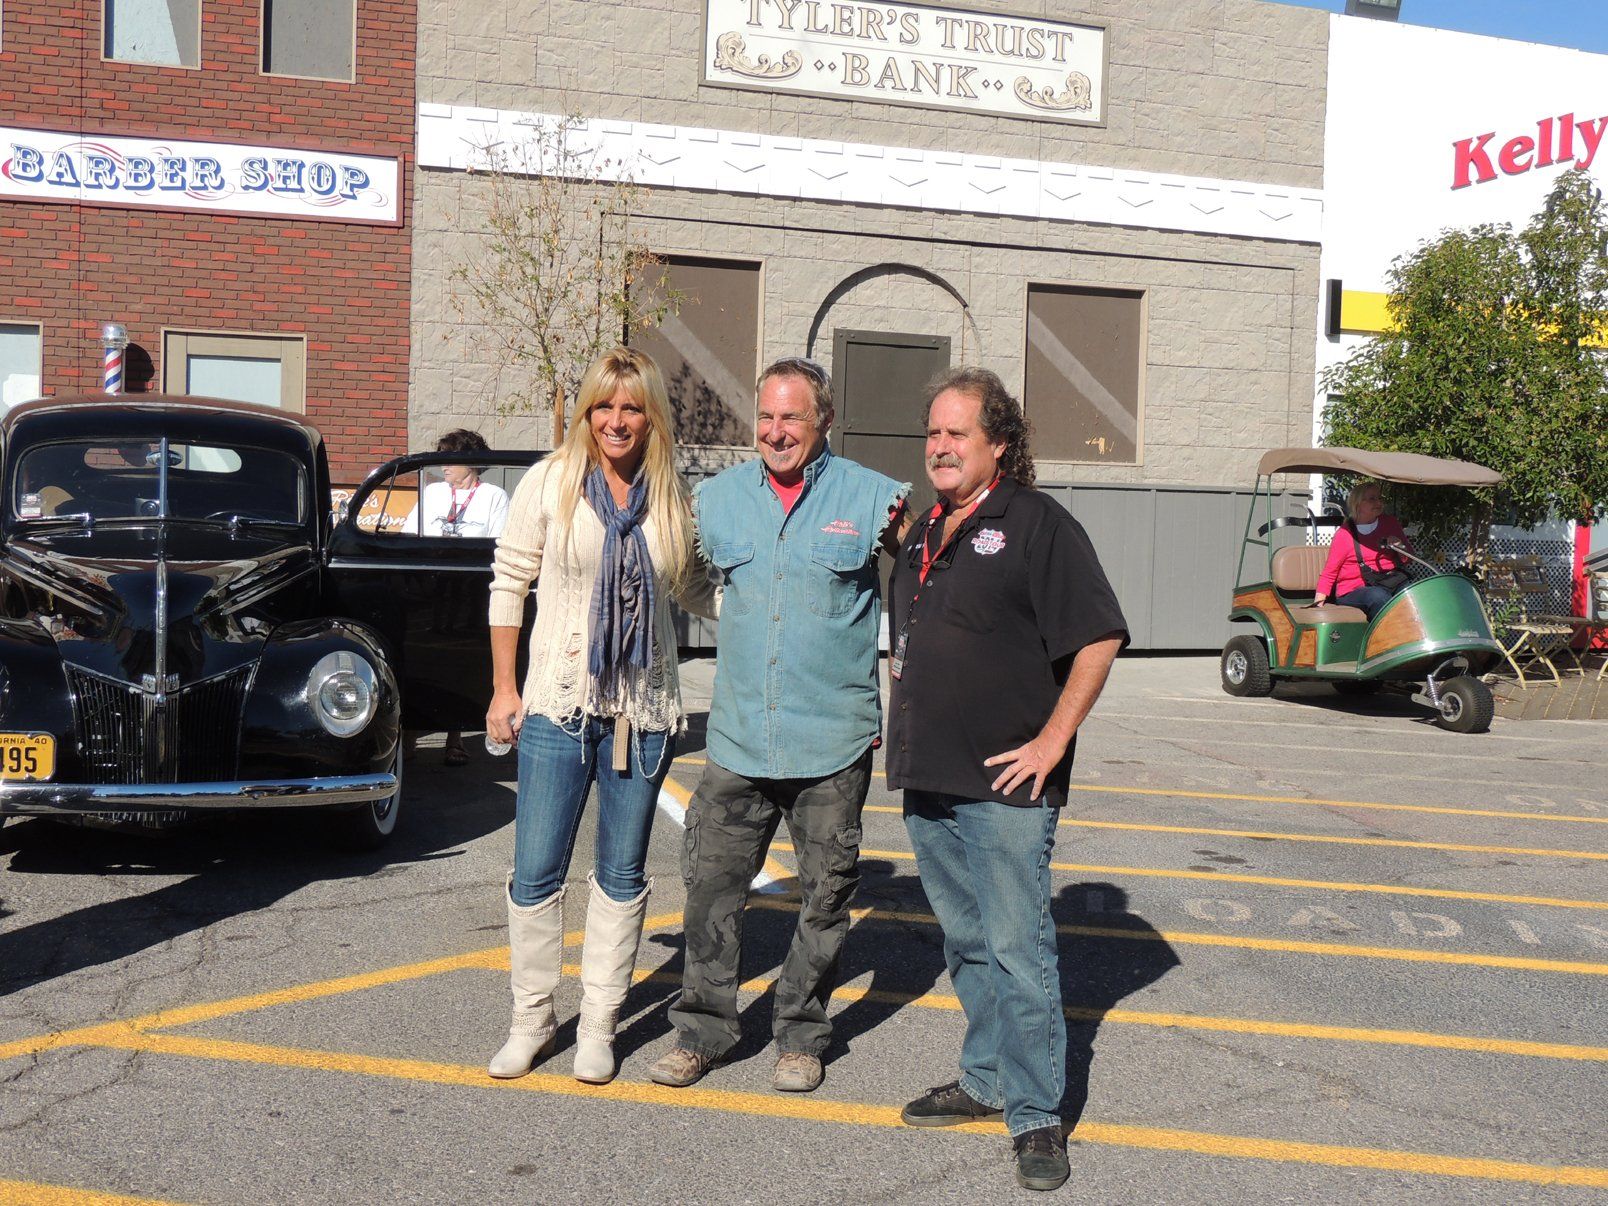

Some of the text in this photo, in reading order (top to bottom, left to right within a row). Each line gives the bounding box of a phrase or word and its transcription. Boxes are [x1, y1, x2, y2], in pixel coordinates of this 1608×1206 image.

[745, 0, 1073, 62] TYLER'S TRUST
[841, 52, 979, 99] BANK
[10, 143, 371, 200] BARBER SHOP
[1451, 112, 1608, 191] Kelly
[34, 737, 47, 745] 40
